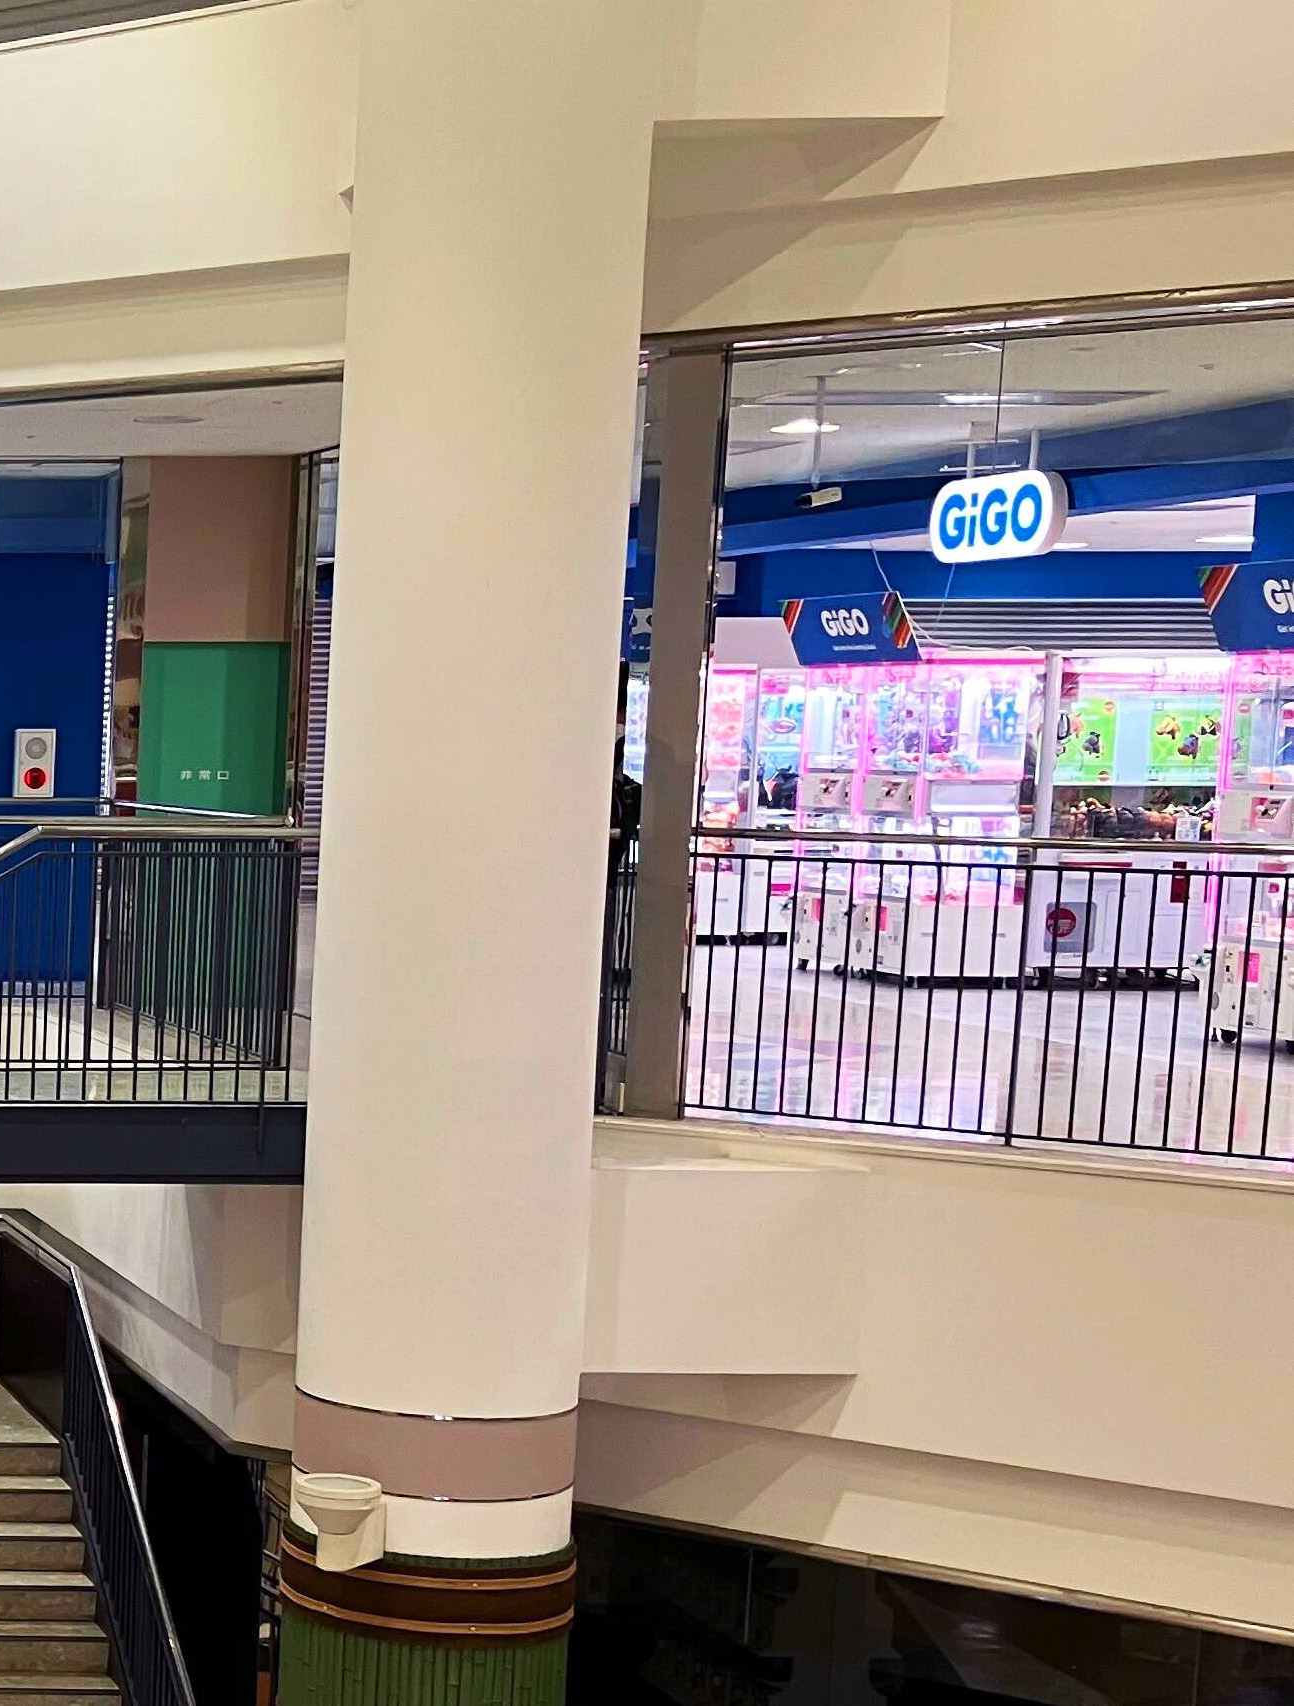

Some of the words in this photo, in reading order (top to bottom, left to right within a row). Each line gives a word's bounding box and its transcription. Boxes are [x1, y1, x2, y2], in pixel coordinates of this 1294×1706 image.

[939, 483, 1043, 550] GiGO
[1263, 578, 1294, 614] Gi
[820, 608, 870, 637] GiGO
